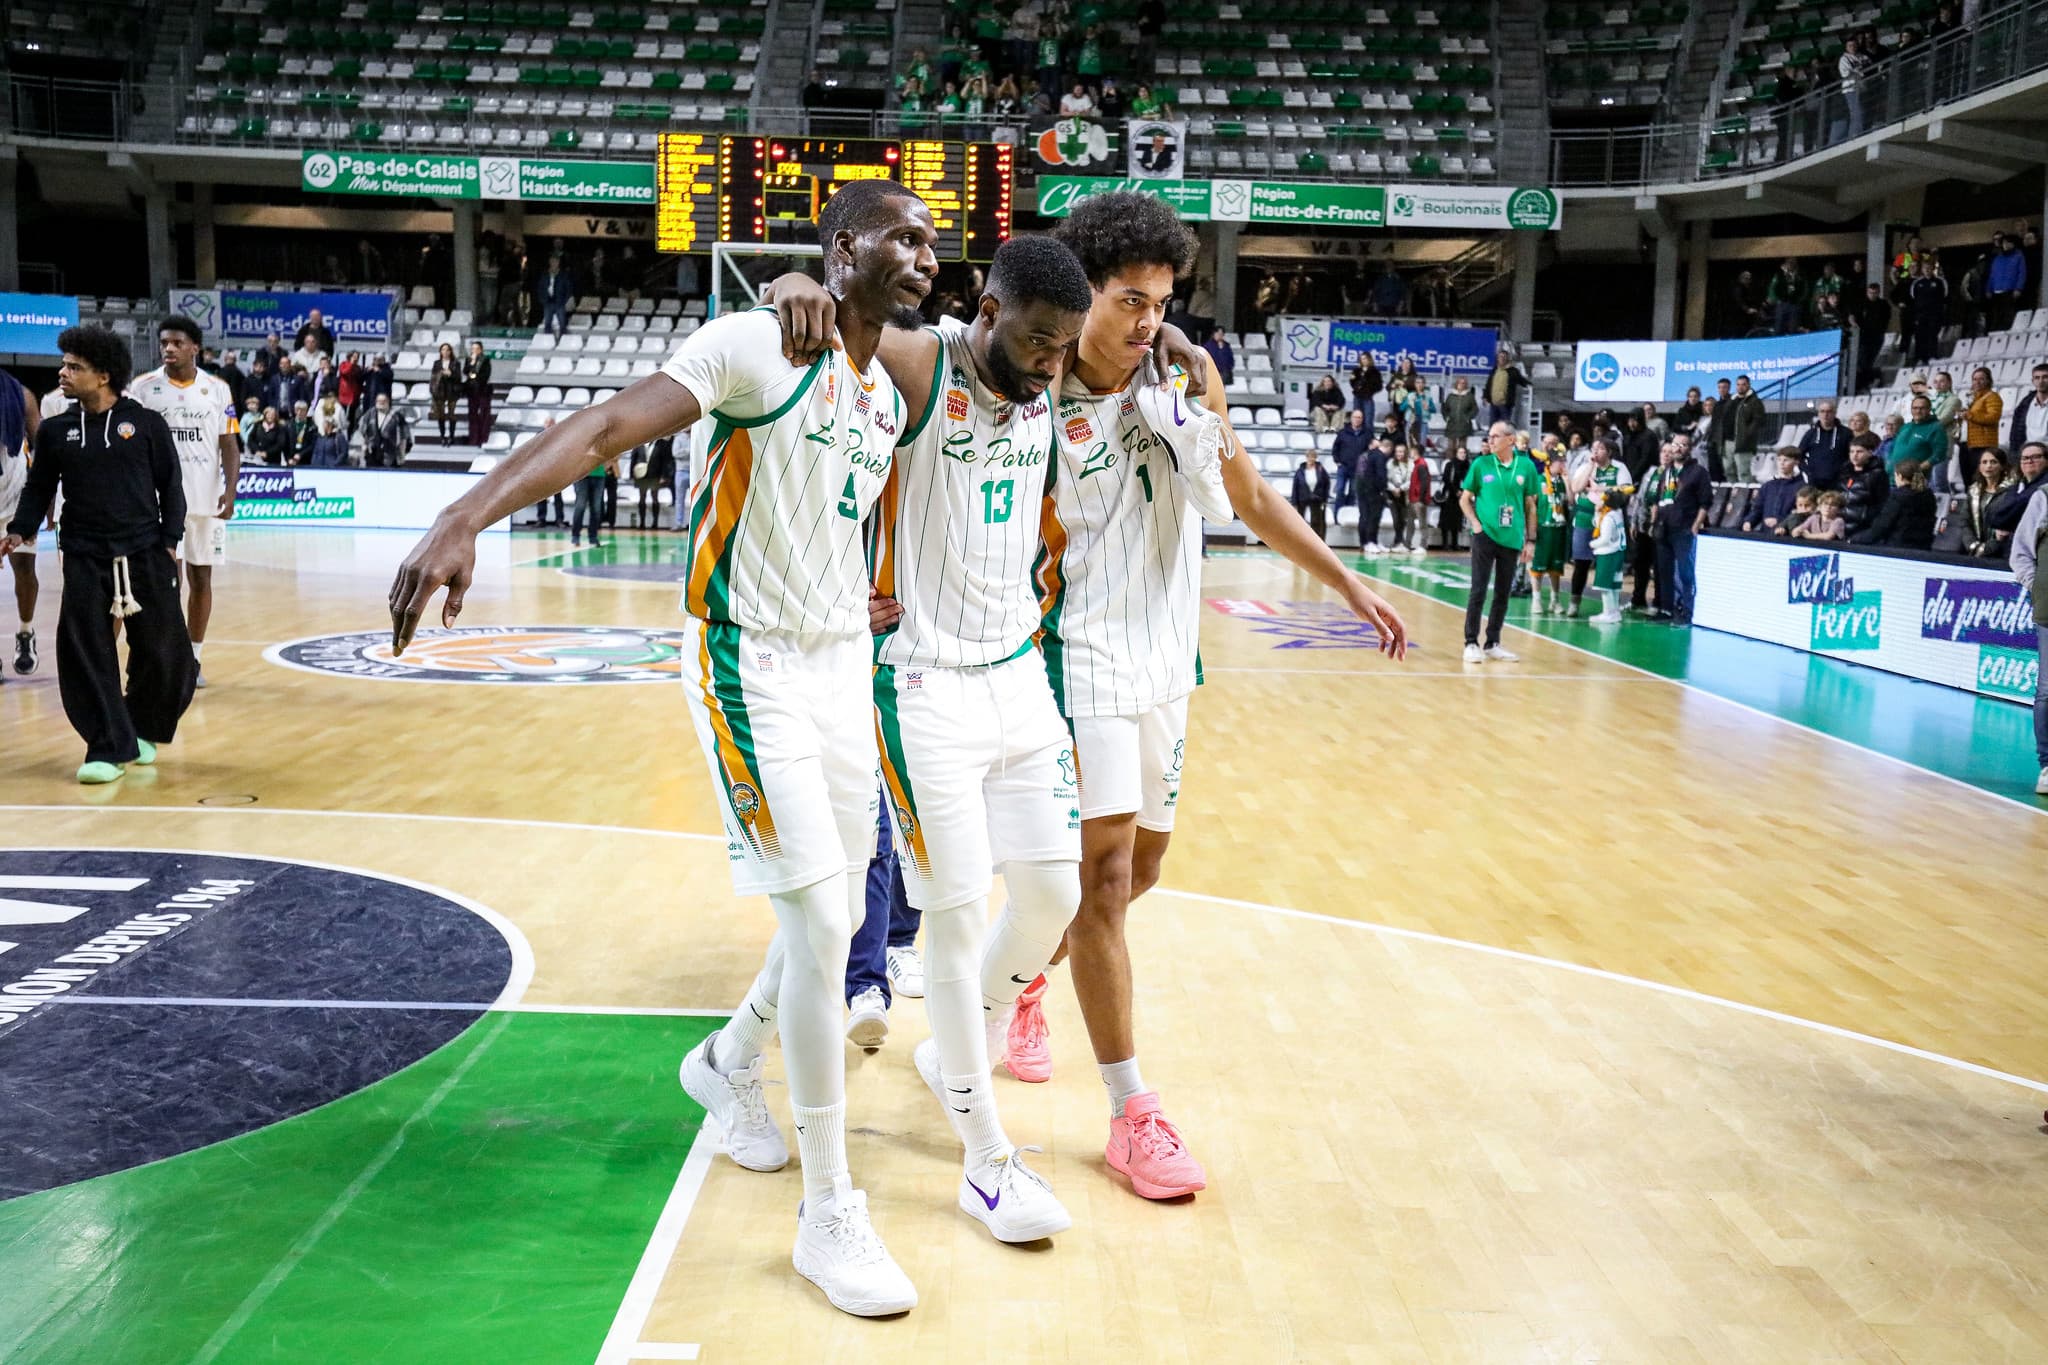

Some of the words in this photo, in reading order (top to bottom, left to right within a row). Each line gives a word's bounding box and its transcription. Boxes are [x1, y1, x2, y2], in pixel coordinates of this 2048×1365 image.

[310, 162, 331, 178] 62
[521, 165, 565, 180] Région
[348, 174, 381, 191] Mon
[382, 180, 463, 196] Département
[521, 180, 652, 198] Hauts-de-France
[1253, 187, 1296, 201] Région
[1252, 202, 1381, 221] Hauts-de-France
[1423, 203, 1502, 216] Boulonnais
[586, 219, 600, 234] V
[225, 297, 279, 312] Région
[7, 312, 67, 326] tertiaires
[226, 313, 387, 333] Hauts-dFrance
[1333, 328, 1385, 345] Région
[1585, 357, 1614, 383] bc
[1623, 367, 1655, 377] NORD
[1674, 361, 1695, 371] Des
[1060, 405, 1082, 418] errea
[1067, 428, 1093, 442] KING
[942, 430, 978, 464] Le
[1079, 441, 1119, 480] Le
[1136, 463, 1153, 503] 1
[981, 480, 1014, 523] 13
[1791, 552, 1836, 600] vert
[1924, 580, 1955, 630] du
[1814, 602, 1881, 640] terre
[1980, 655, 2039, 692] cons
[54, 913, 193, 964] DEPUIS
[156, 879, 255, 909] 1964
